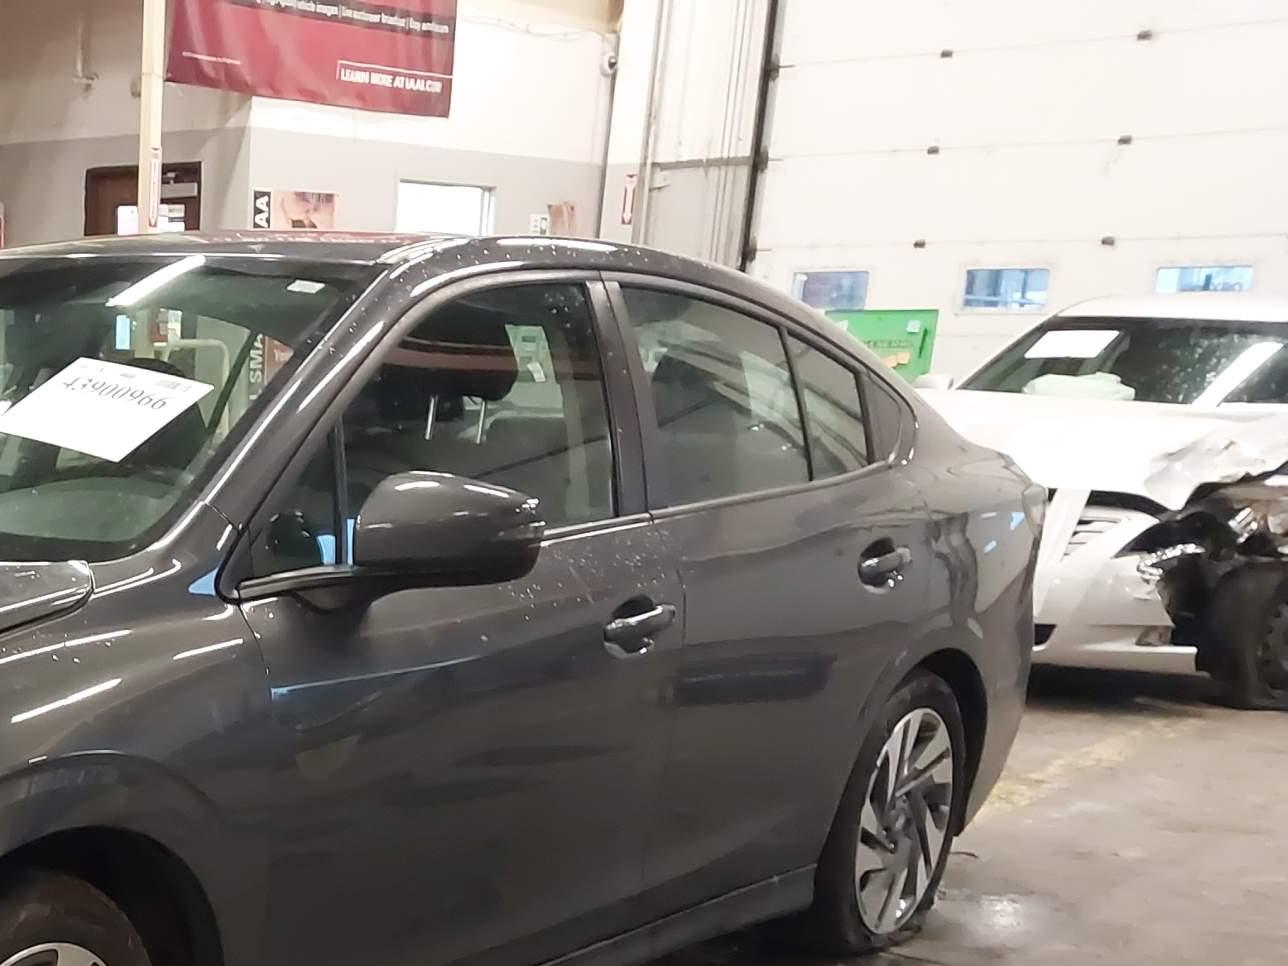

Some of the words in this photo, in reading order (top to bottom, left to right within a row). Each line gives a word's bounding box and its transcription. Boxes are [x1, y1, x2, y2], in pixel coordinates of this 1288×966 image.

[340, 68, 370, 84] LEARN
[370, 72, 393, 88] MORE
[393, 75, 405, 89] AT
